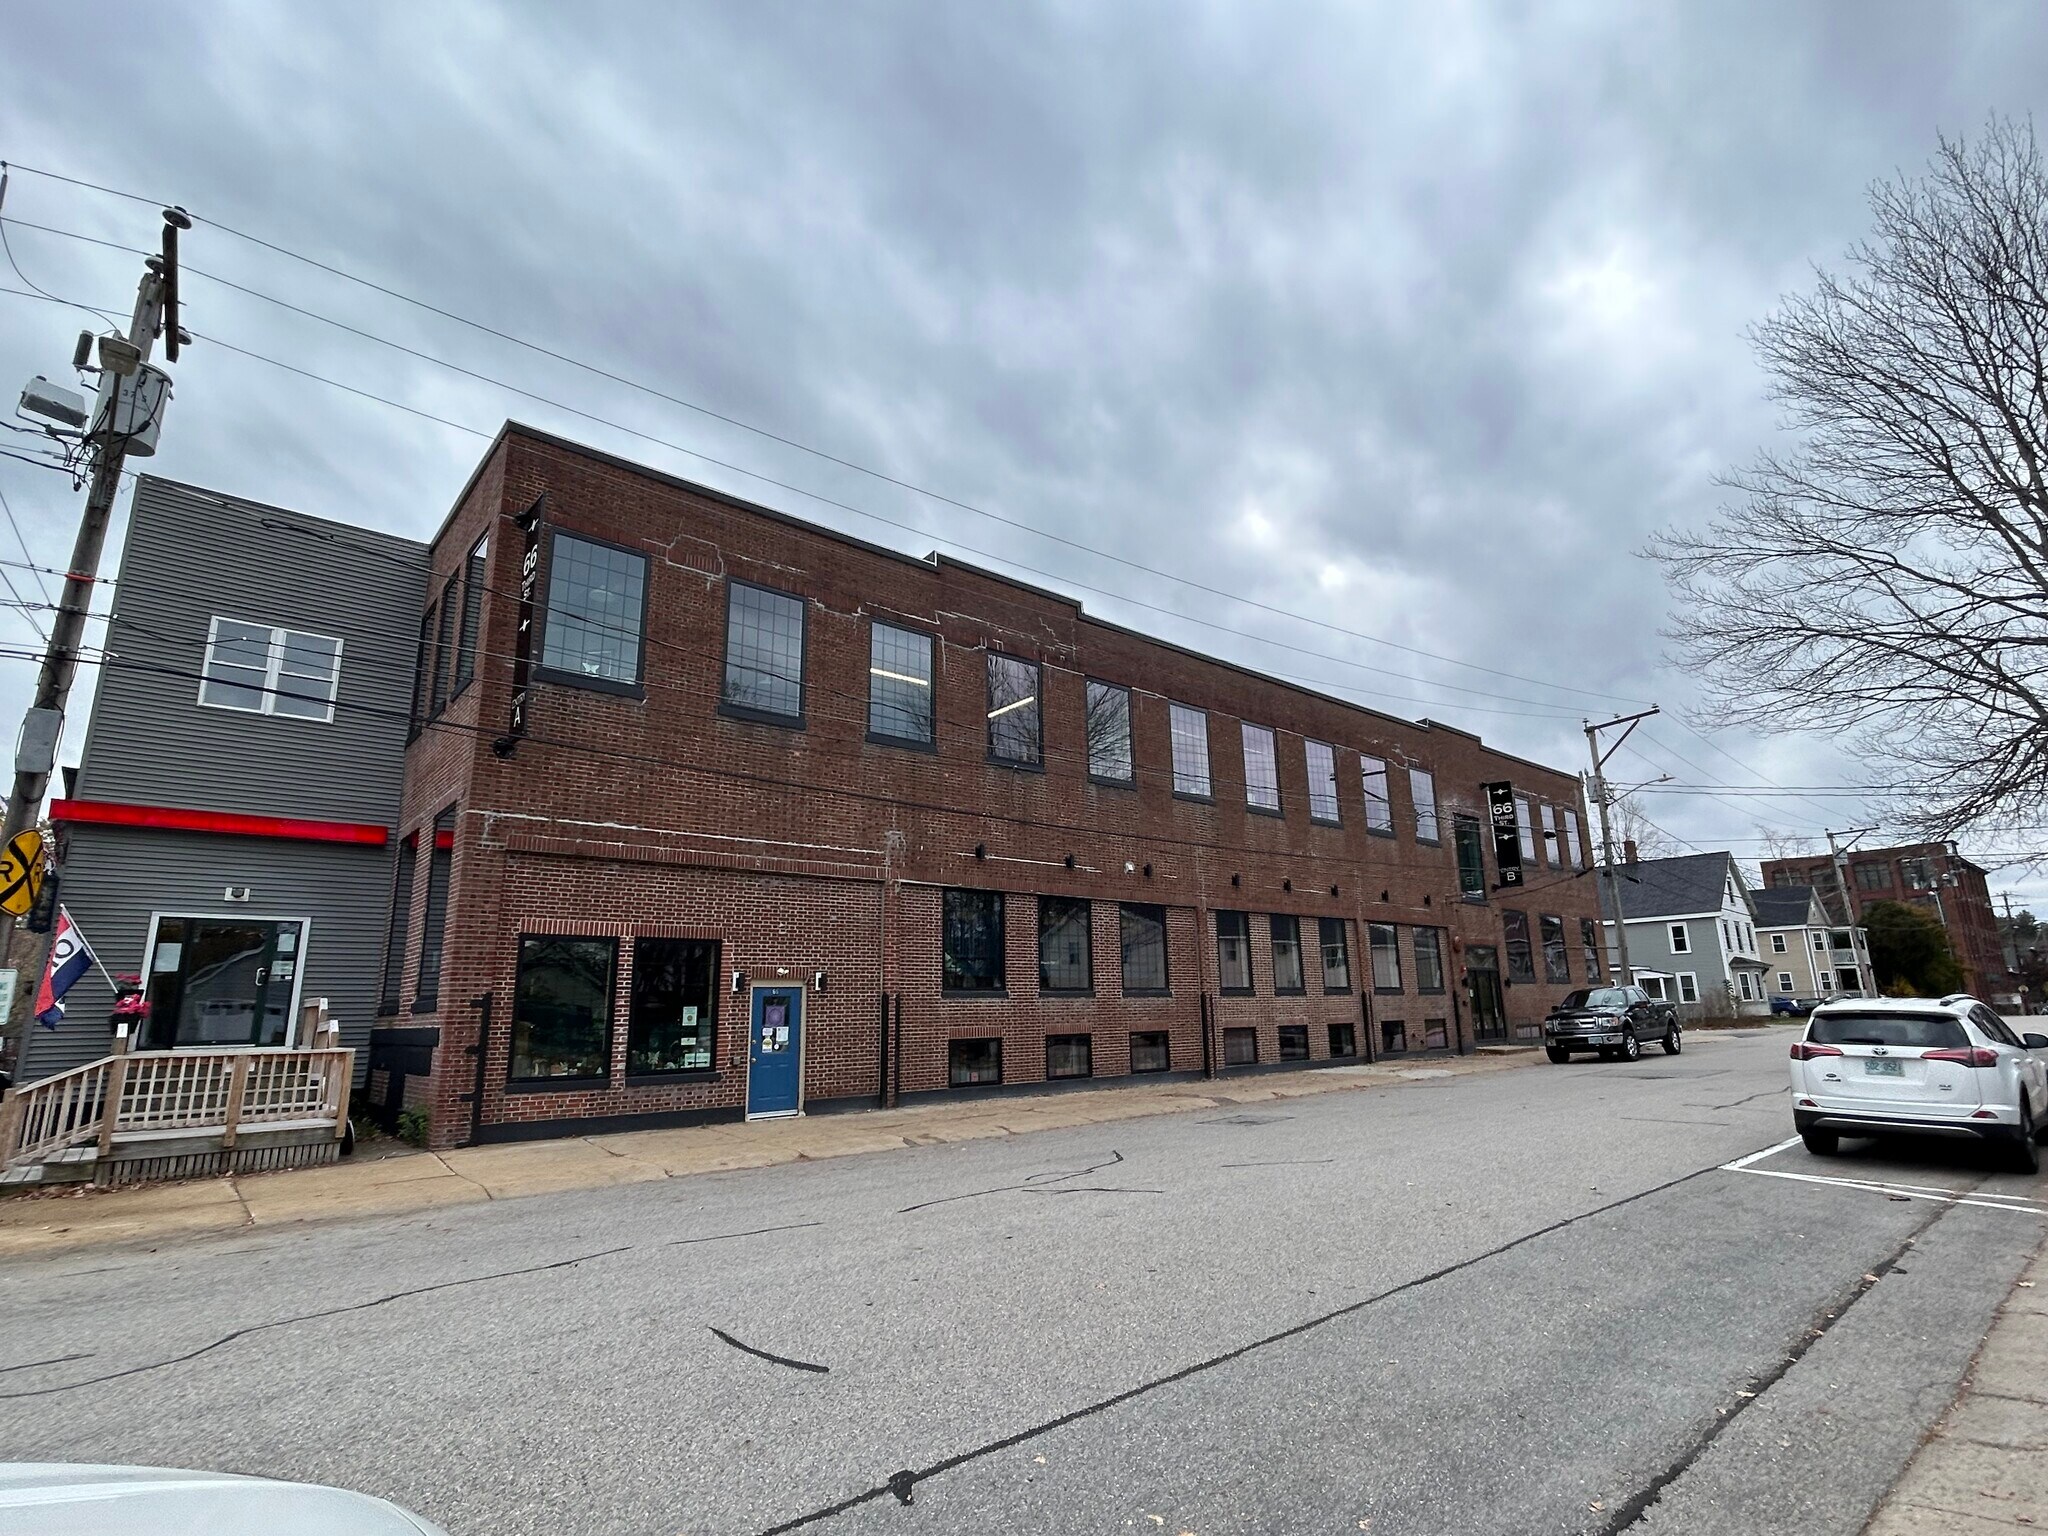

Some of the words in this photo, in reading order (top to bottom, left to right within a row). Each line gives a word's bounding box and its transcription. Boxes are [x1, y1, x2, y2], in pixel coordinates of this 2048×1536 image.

[523, 544, 538, 576] 66
[513, 706, 521, 727] A
[1493, 802, 1513, 814] 66
[1507, 871, 1516, 881] B
